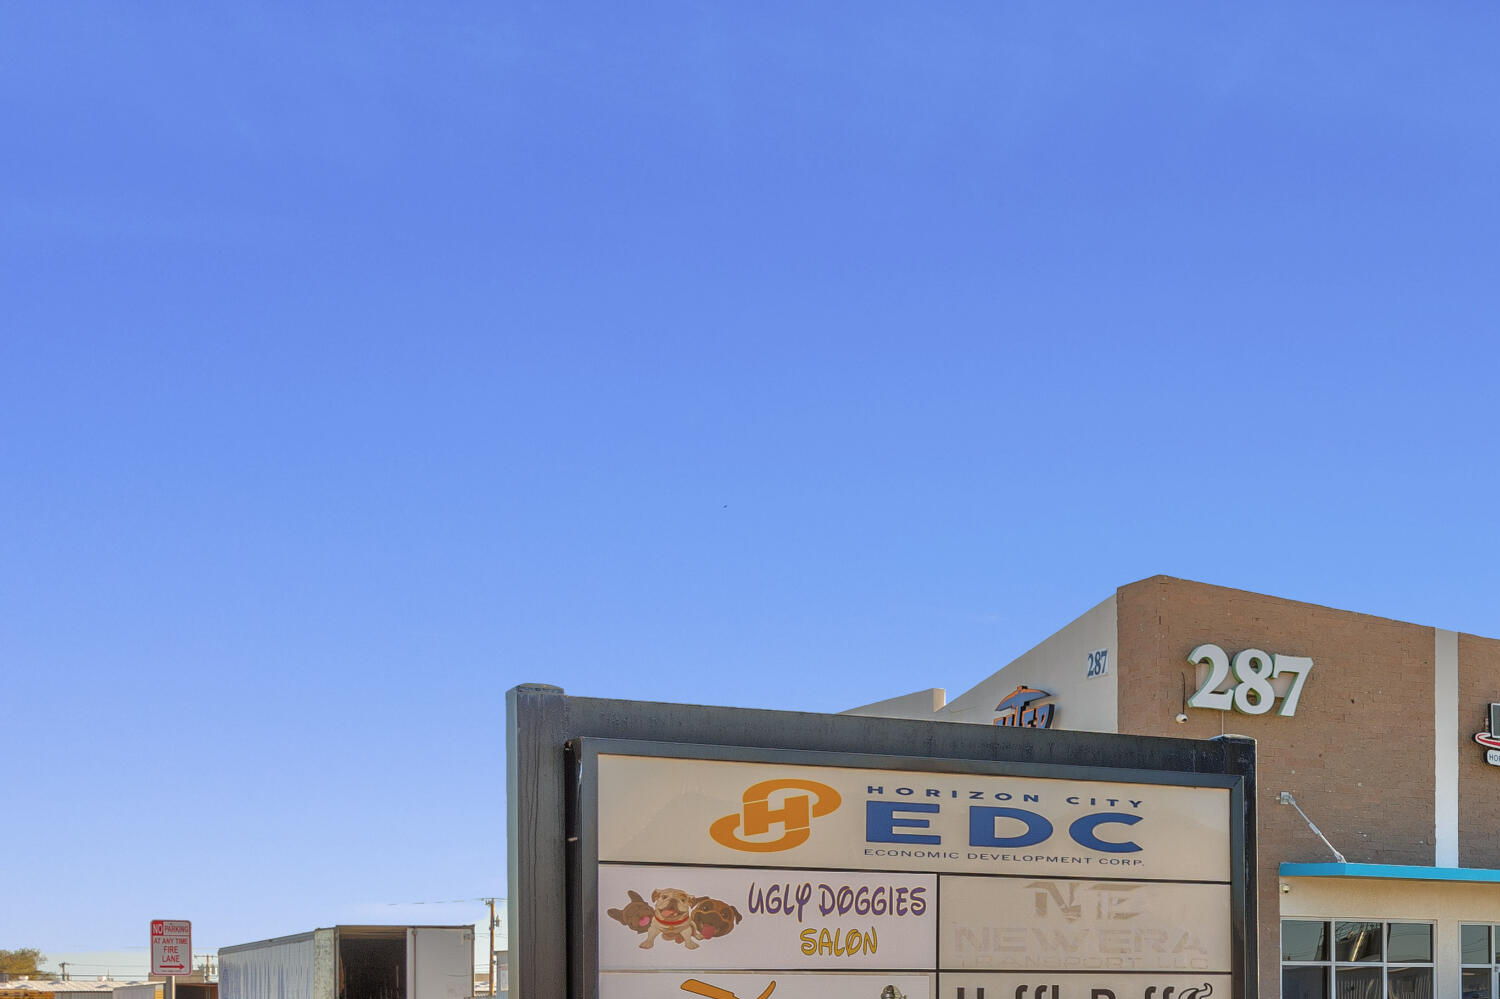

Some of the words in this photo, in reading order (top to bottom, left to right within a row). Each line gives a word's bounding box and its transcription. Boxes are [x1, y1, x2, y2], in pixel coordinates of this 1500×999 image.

[1087, 650, 1108, 677] 287
[1187, 643, 1314, 717] 287
[867, 785, 1040, 803] HORIZON
[1066, 796, 1144, 808] CITY
[865, 800, 1144, 854] EDC
[864, 848, 960, 859] ECONOMIC
[967, 852, 1093, 865] DEVELOPMENT
[1099, 857, 1145, 866] CORP.
[748, 881, 812, 923] UGLY
[818, 883, 928, 917] DOGGIES
[152, 924, 163, 934] NO
[164, 925, 189, 933] PARKING
[799, 926, 878, 957] SALON
[954, 927, 1089, 953] NEW
[1098, 928, 1208, 954] ERA
